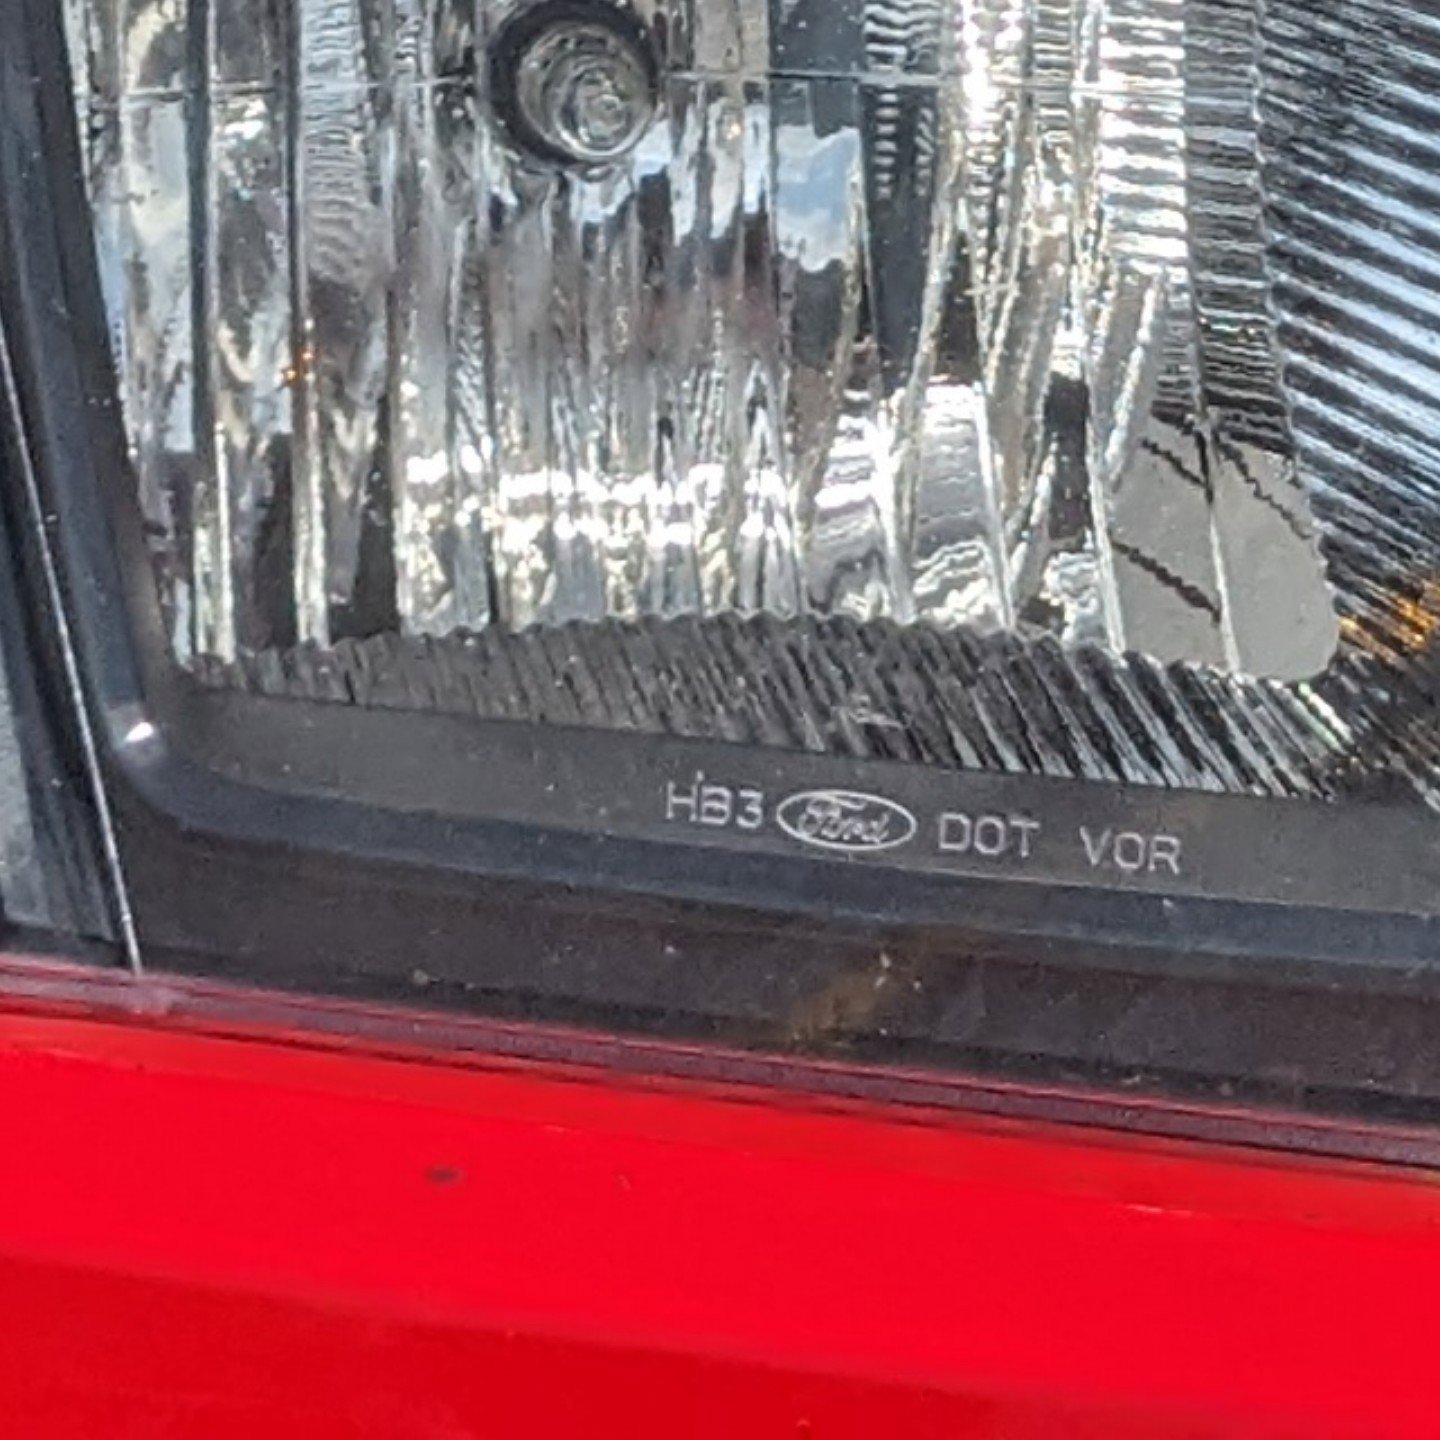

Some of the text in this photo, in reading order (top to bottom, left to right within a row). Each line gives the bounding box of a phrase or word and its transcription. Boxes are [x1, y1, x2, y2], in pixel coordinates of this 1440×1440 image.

[794, 794, 891, 846] Ford
[937, 812, 1040, 859] DOT
[1078, 824, 1182, 874] VOR
